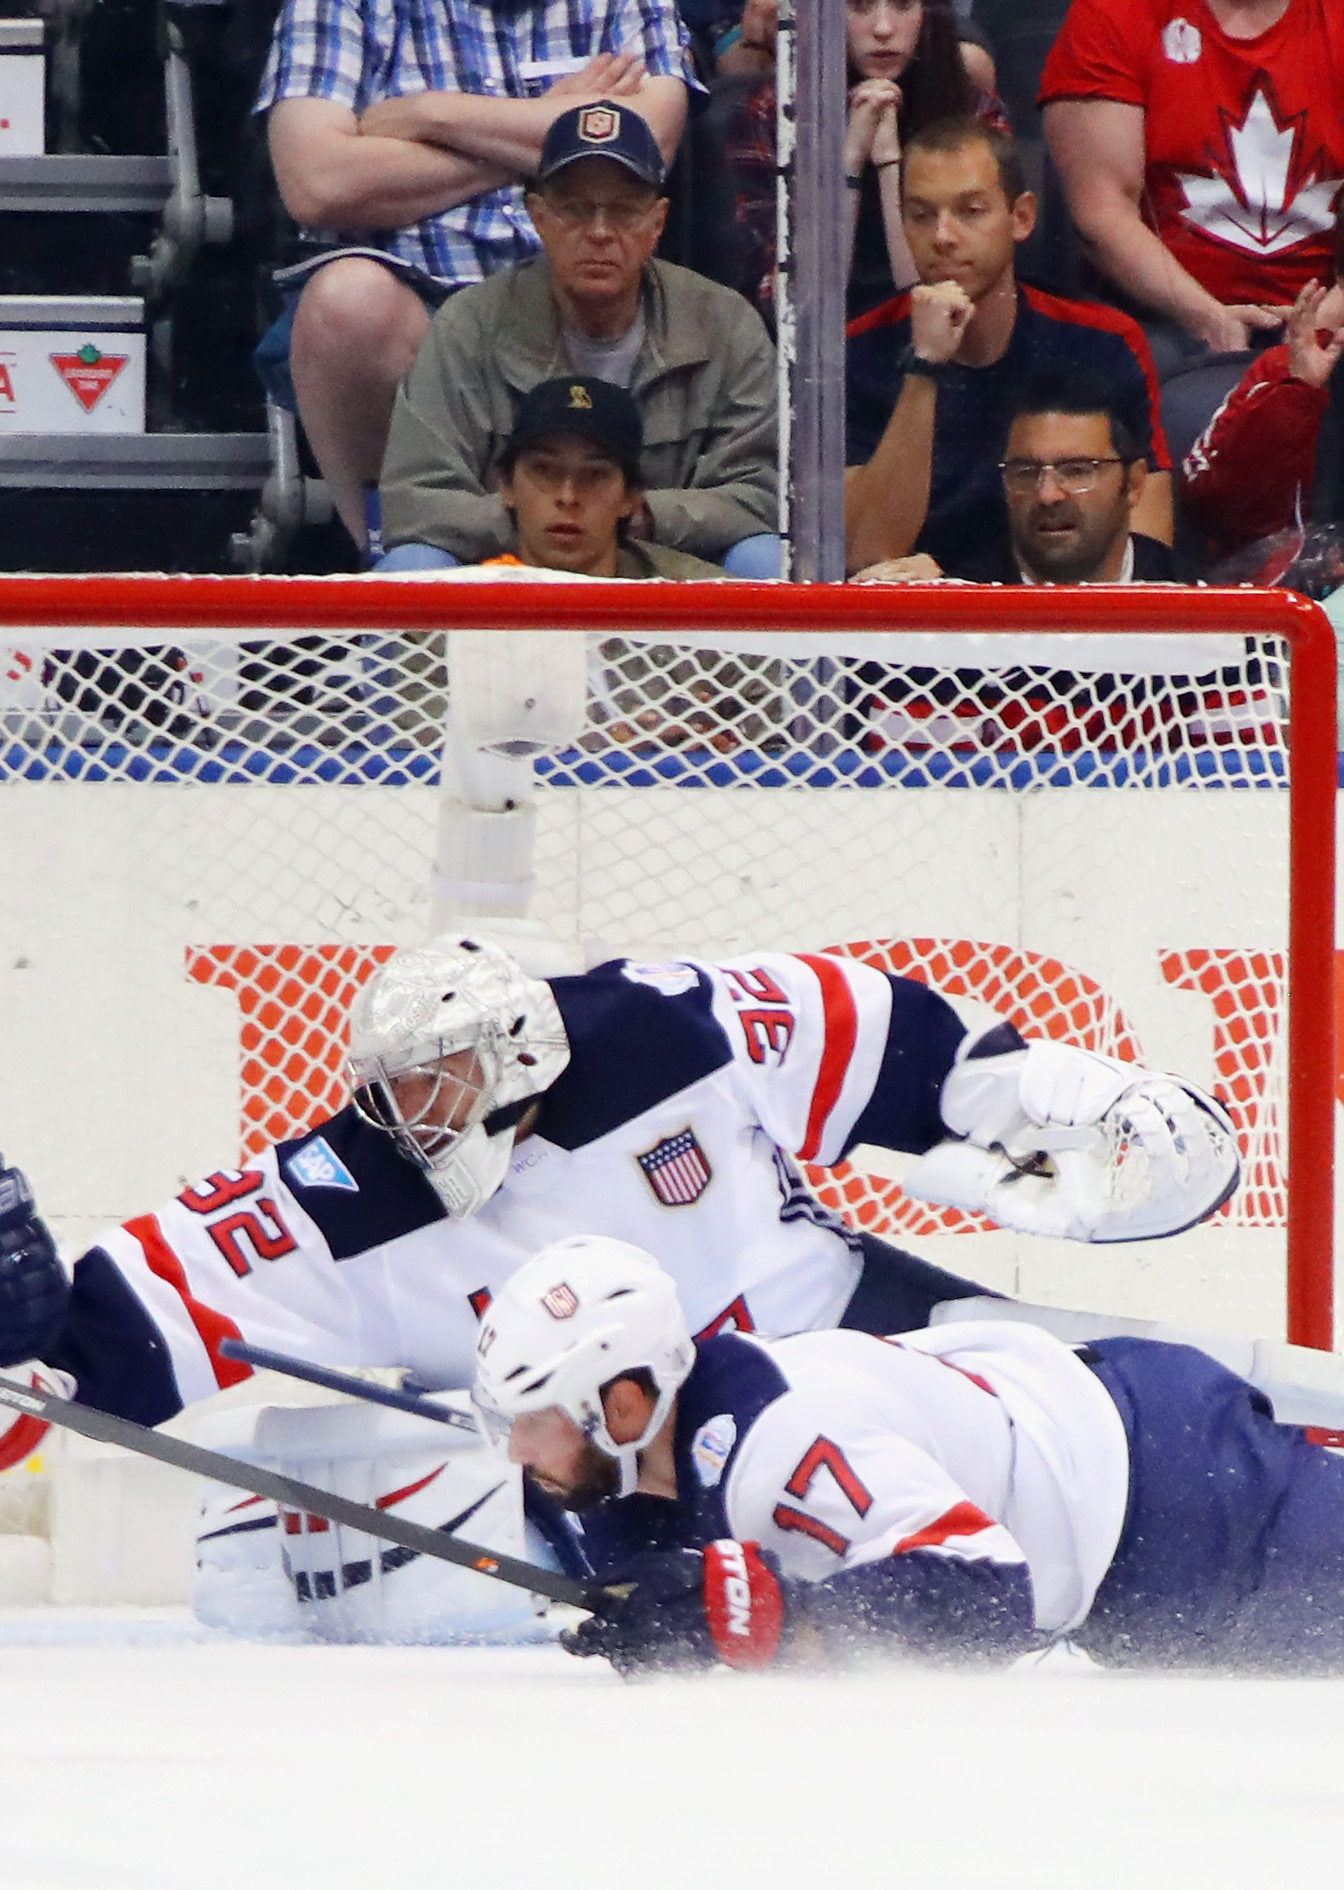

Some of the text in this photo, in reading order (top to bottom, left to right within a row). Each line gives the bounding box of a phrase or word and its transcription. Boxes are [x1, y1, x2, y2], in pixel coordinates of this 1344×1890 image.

[298, 1142, 338, 1182] SAP
[176, 1168, 301, 1279] 32
[771, 1432, 875, 1559] 17
